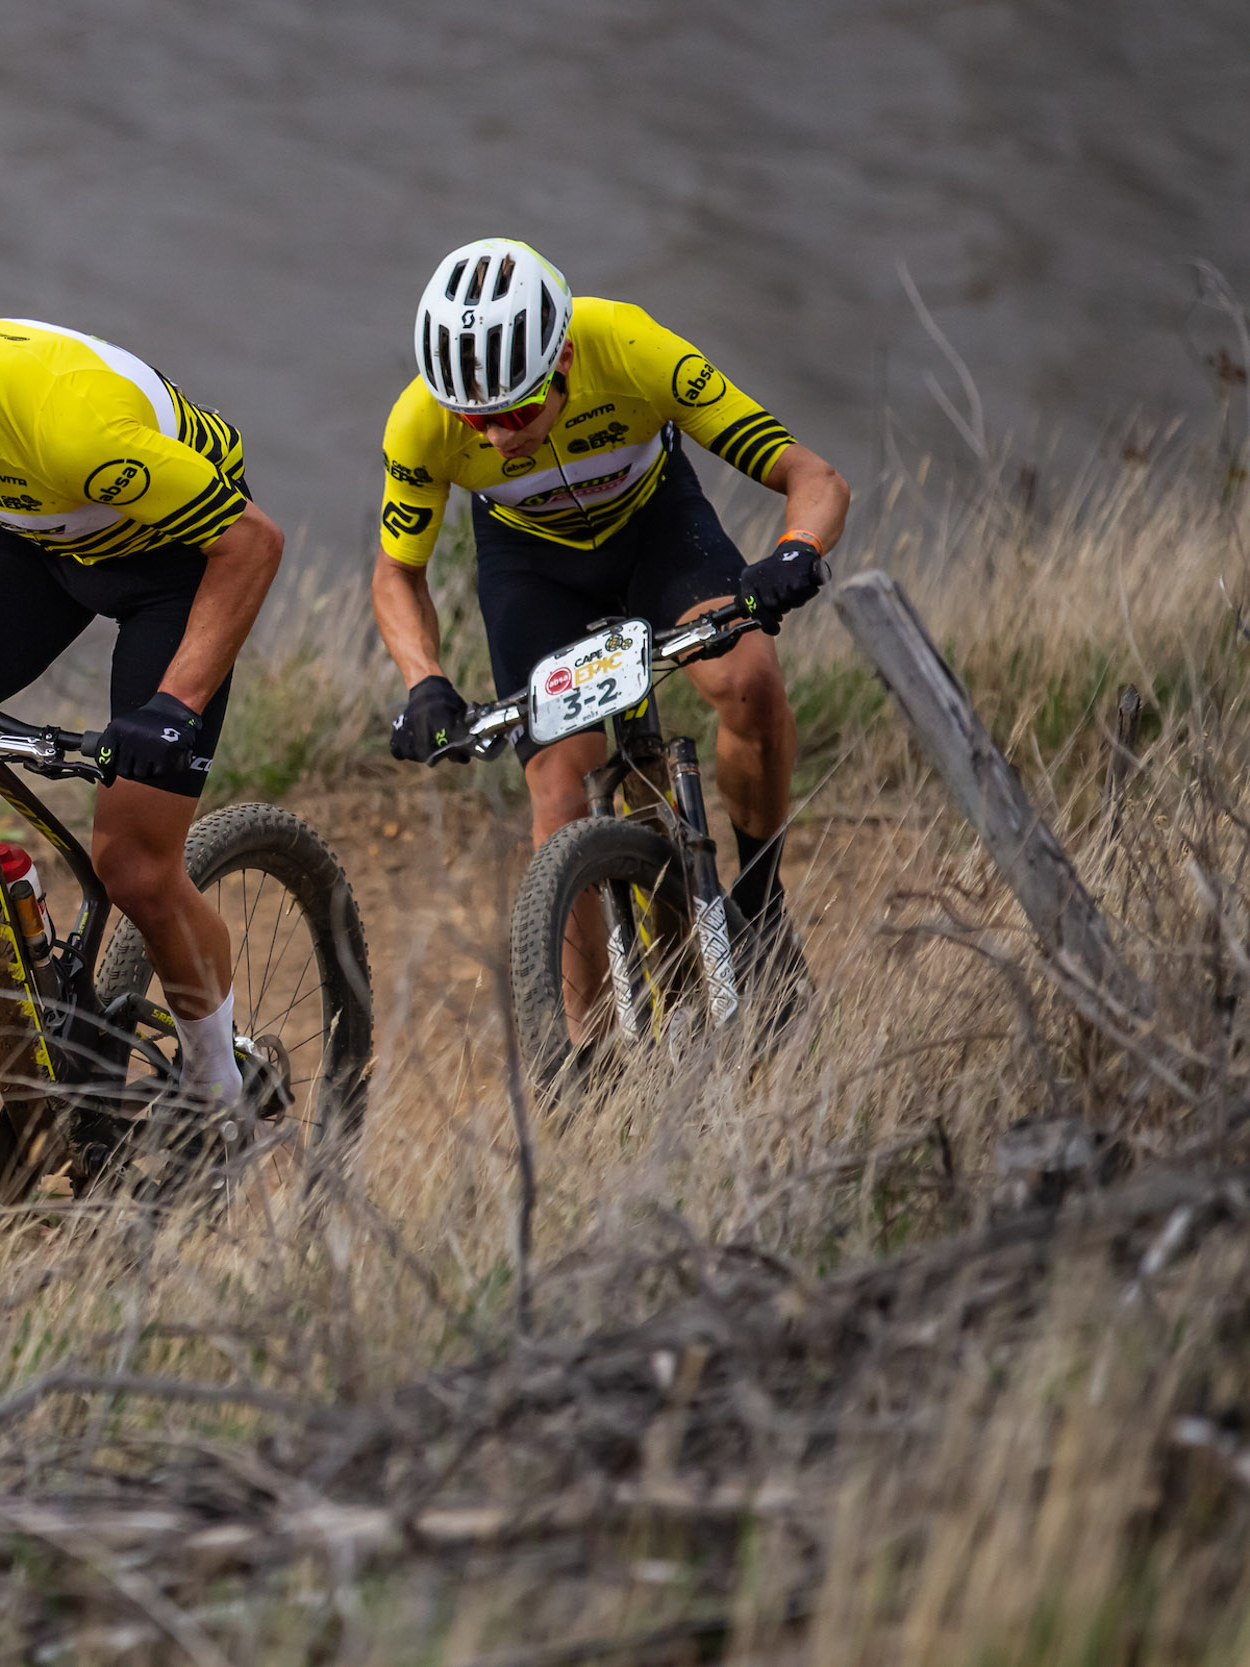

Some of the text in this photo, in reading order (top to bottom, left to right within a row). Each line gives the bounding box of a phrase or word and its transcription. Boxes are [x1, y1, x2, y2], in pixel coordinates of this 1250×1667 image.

[685, 363, 715, 401] absa
[589, 432, 626, 450] EPIC
[99, 466, 138, 502] absa
[391, 465, 425, 488] EPIC
[574, 649, 603, 668] CAPE
[575, 651, 623, 687] EPIC
[563, 677, 618, 721] 3-2
